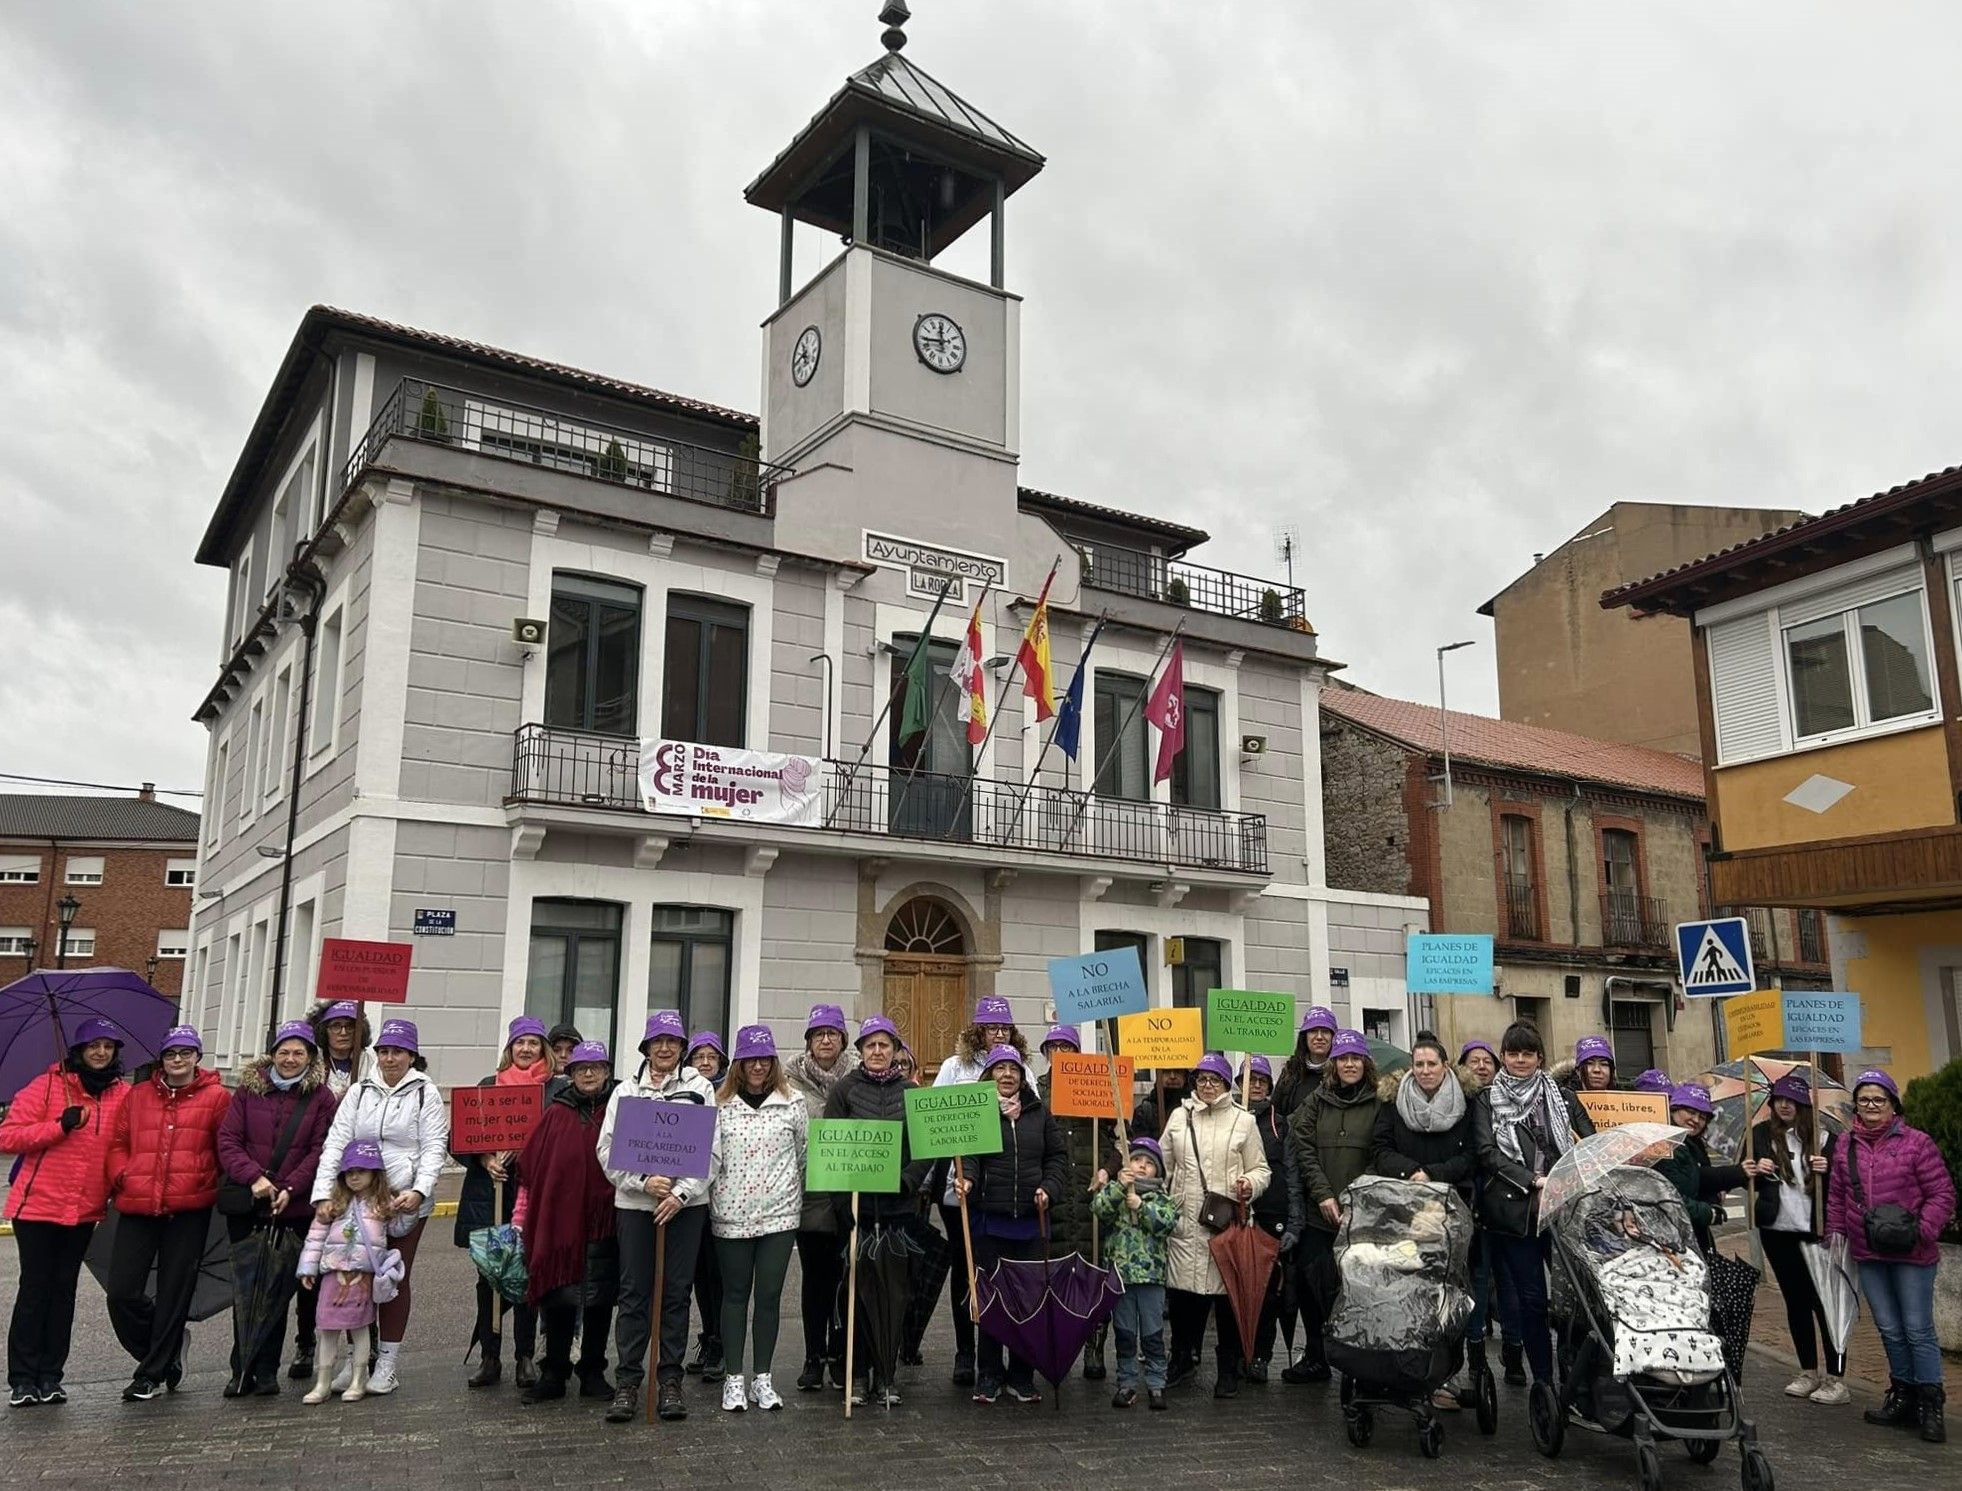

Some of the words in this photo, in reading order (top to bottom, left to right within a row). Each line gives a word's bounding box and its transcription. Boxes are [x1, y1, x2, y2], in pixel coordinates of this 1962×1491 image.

[873, 541, 997, 577] Ayuntamiento
[912, 573, 925, 589] LA
[693, 747, 721, 762] Día
[672, 743, 686, 796] MARZO
[692, 760, 784, 780] Internacional
[692, 773, 704, 783] de
[707, 775, 719, 785] la
[691, 782, 764, 807] mujer
[1422, 943, 1462, 951] PLANES
[1463, 943, 1478, 951] DE
[332, 949, 403, 963] IGUALDAD
[1422, 955, 1478, 964] IGUALDAD
[1081, 962, 1109, 979] NO
[1068, 990, 1075, 998] A
[1076, 987, 1090, 997] LA
[1091, 980, 1130, 994] BRECHA
[1077, 995, 1125, 1010] SALARIAL
[1217, 998, 1286, 1012] IGUALDAD
[1786, 1000, 1827, 1009] PLANES
[1828, 1000, 1844, 1009] DE
[1147, 1018, 1172, 1030] NO
[1220, 1014, 1232, 1022] EN
[1234, 1015, 1245, 1023] EL
[1246, 1016, 1283, 1026] ACCESO
[1787, 1013, 1845, 1022] IGUALDAD
[1223, 1027, 1235, 1035] AL
[1236, 1027, 1278, 1038] TRABAJO
[1791, 1026, 1827, 1034] EFICACES
[1143, 1036, 1196, 1044] TEMPORALIDAD
[1804, 1036, 1846, 1044] EMPRESAS
[1061, 1061, 1128, 1075] IGUALDD
[1080, 1078, 1119, 1087] DERECH
[1072, 1089, 1108, 1097] SOCIALES
[462, 1096, 483, 1110] Voy
[488, 1098, 495, 1106] a
[499, 1096, 517, 1106] ser
[521, 1094, 532, 1105] la
[914, 1092, 988, 1110] IGUALDAD
[1072, 1099, 1115, 1108] LABORALES
[1586, 1102, 1619, 1112] Vivas,
[1621, 1102, 1656, 1113] libres,
[465, 1114, 501, 1127] mujer
[505, 1114, 528, 1126] que
[654, 1111, 680, 1126] NO
[924, 1115, 935, 1123] DE
[937, 1110, 981, 1122] DERECHOS
[929, 1123, 969, 1135] SOCIALES
[968, 1123, 976, 1131] Y
[1592, 1119, 1623, 1128] nida
[465, 1132, 505, 1145] quiero
[508, 1132, 528, 1141] ser
[818, 1129, 893, 1143] IGUALDAD
[930, 1134, 978, 1147] LABORALES
[628, 1139, 697, 1154] PRECARIEDAD
[637, 1154, 683, 1166] LABORAL
[820, 1148, 834, 1157] EN
[837, 1148, 848, 1157] EL
[851, 1149, 890, 1159] ACCESO
[825, 1162, 838, 1172] AL
[841, 1162, 885, 1173] TRABAJO
